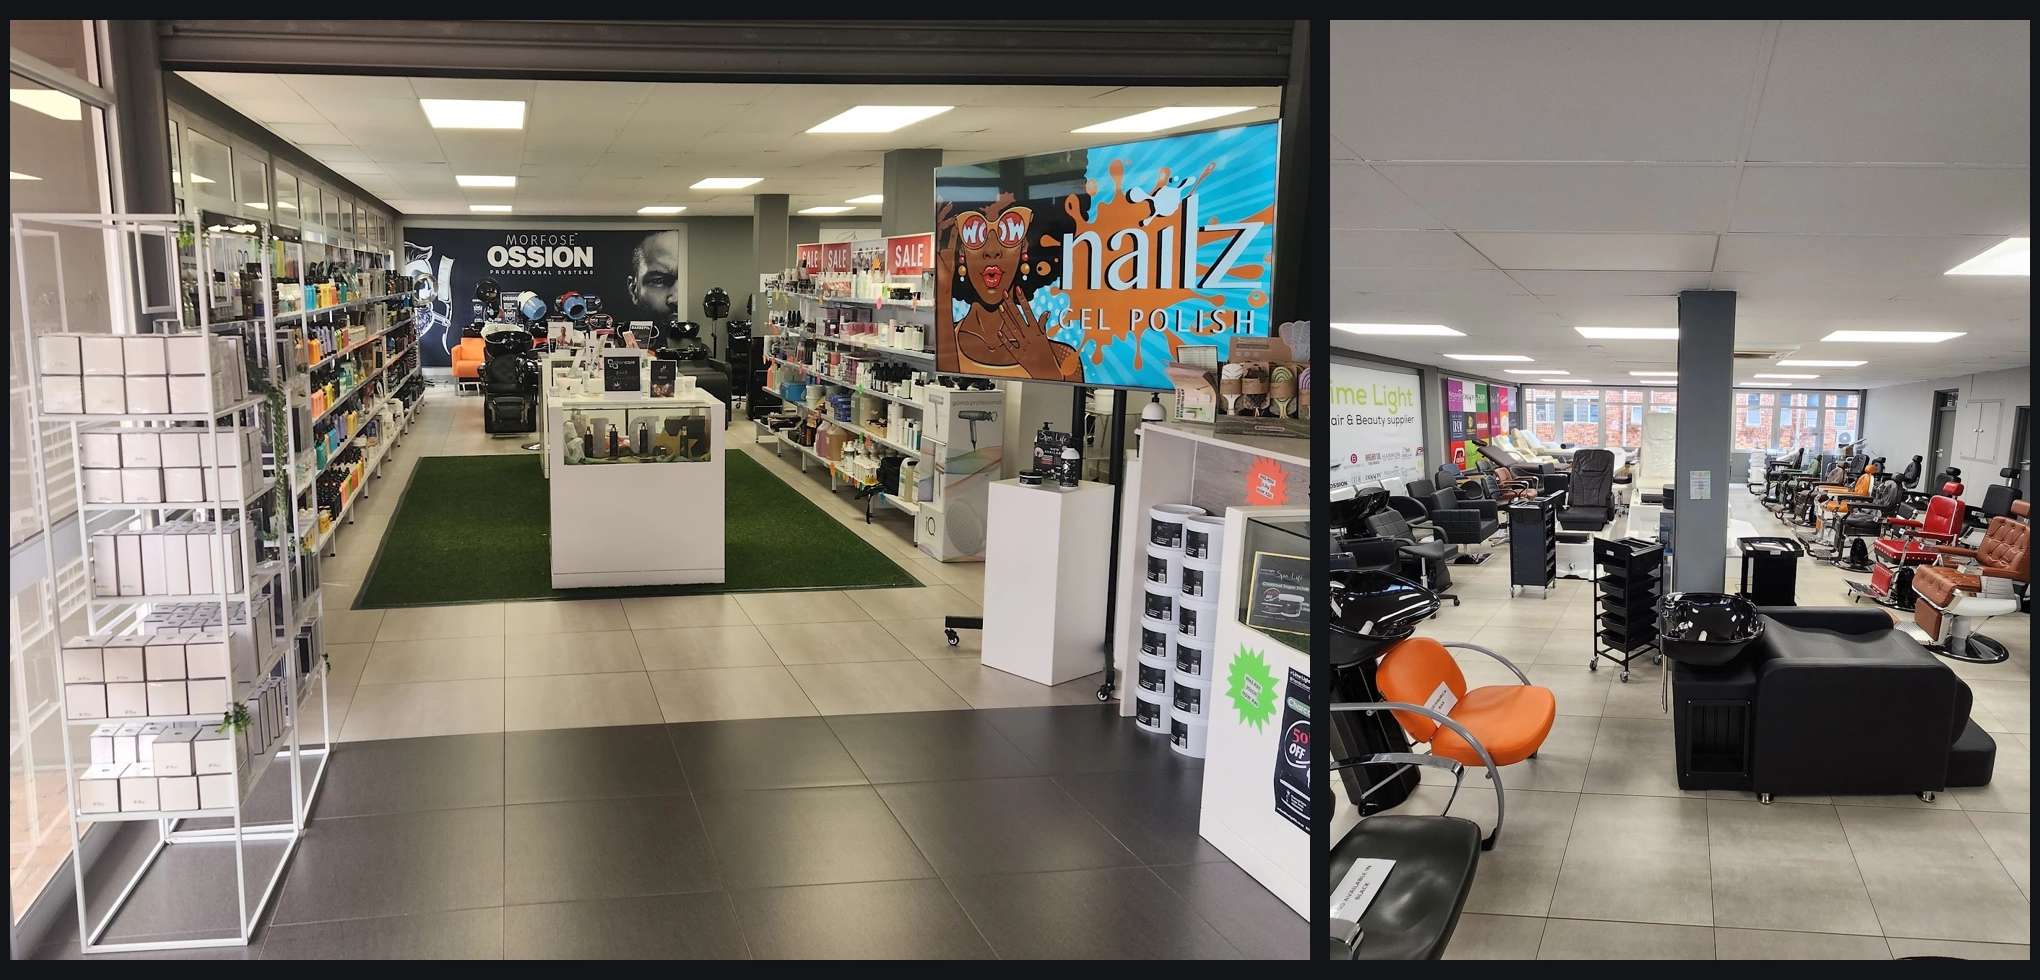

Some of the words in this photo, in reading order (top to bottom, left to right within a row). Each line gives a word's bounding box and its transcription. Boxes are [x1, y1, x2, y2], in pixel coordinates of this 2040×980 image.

[505, 234, 576, 246] MORFOSE
[1060, 184, 1265, 291] nailz
[487, 245, 594, 268] OSSION
[802, 250, 818, 268] SALE
[828, 249, 847, 269] SALE
[895, 243, 924, 267] SALE
[1058, 308, 1111, 330] GEL
[1129, 308, 1255, 334] POLISH
[1372, 383, 1413, 415] Light
[1346, 414, 1354, 426] &
[1356, 414, 1386, 428] Beauty
[1387, 414, 1415, 427] supplier
[1292, 727, 1310, 744] 50
[1289, 743, 1306, 759] OFF
[1344, 872, 1366, 902] AVAILABLE
[1355, 882, 1370, 901] BLACK
